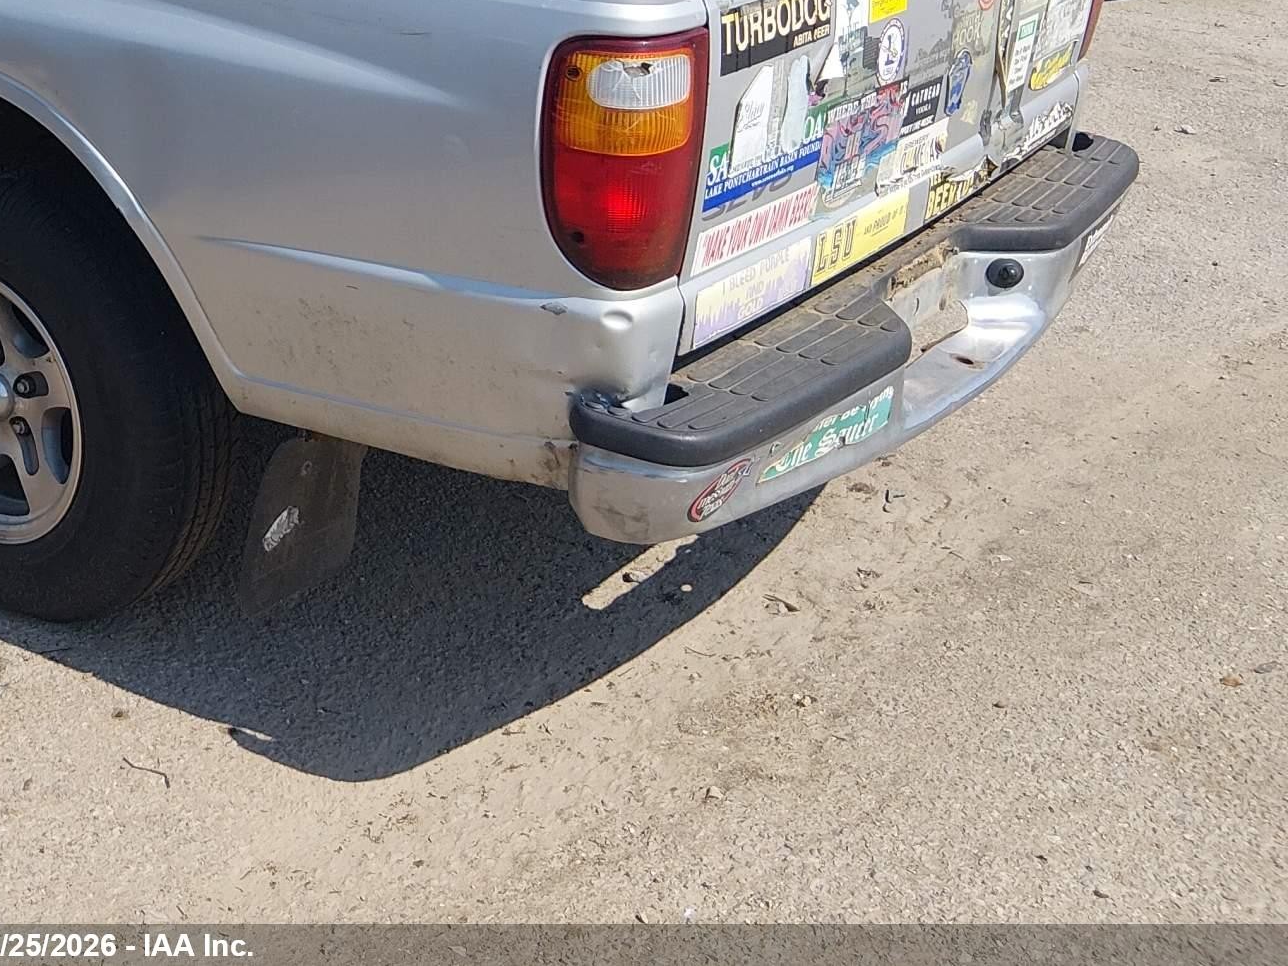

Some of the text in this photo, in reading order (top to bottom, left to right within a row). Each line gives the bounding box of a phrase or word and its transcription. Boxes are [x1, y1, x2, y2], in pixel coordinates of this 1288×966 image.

[793, 33, 812, 48] ABITA
[705, 182, 722, 199] LAKE
[723, 157, 780, 192] PONTCHARTRAIN
[779, 148, 798, 168] BASIN
[816, 218, 857, 274] LSU
[729, 267, 756, 294] BLEED
[759, 249, 791, 277] PURPLE
[737, 296, 764, 318] GOLD
